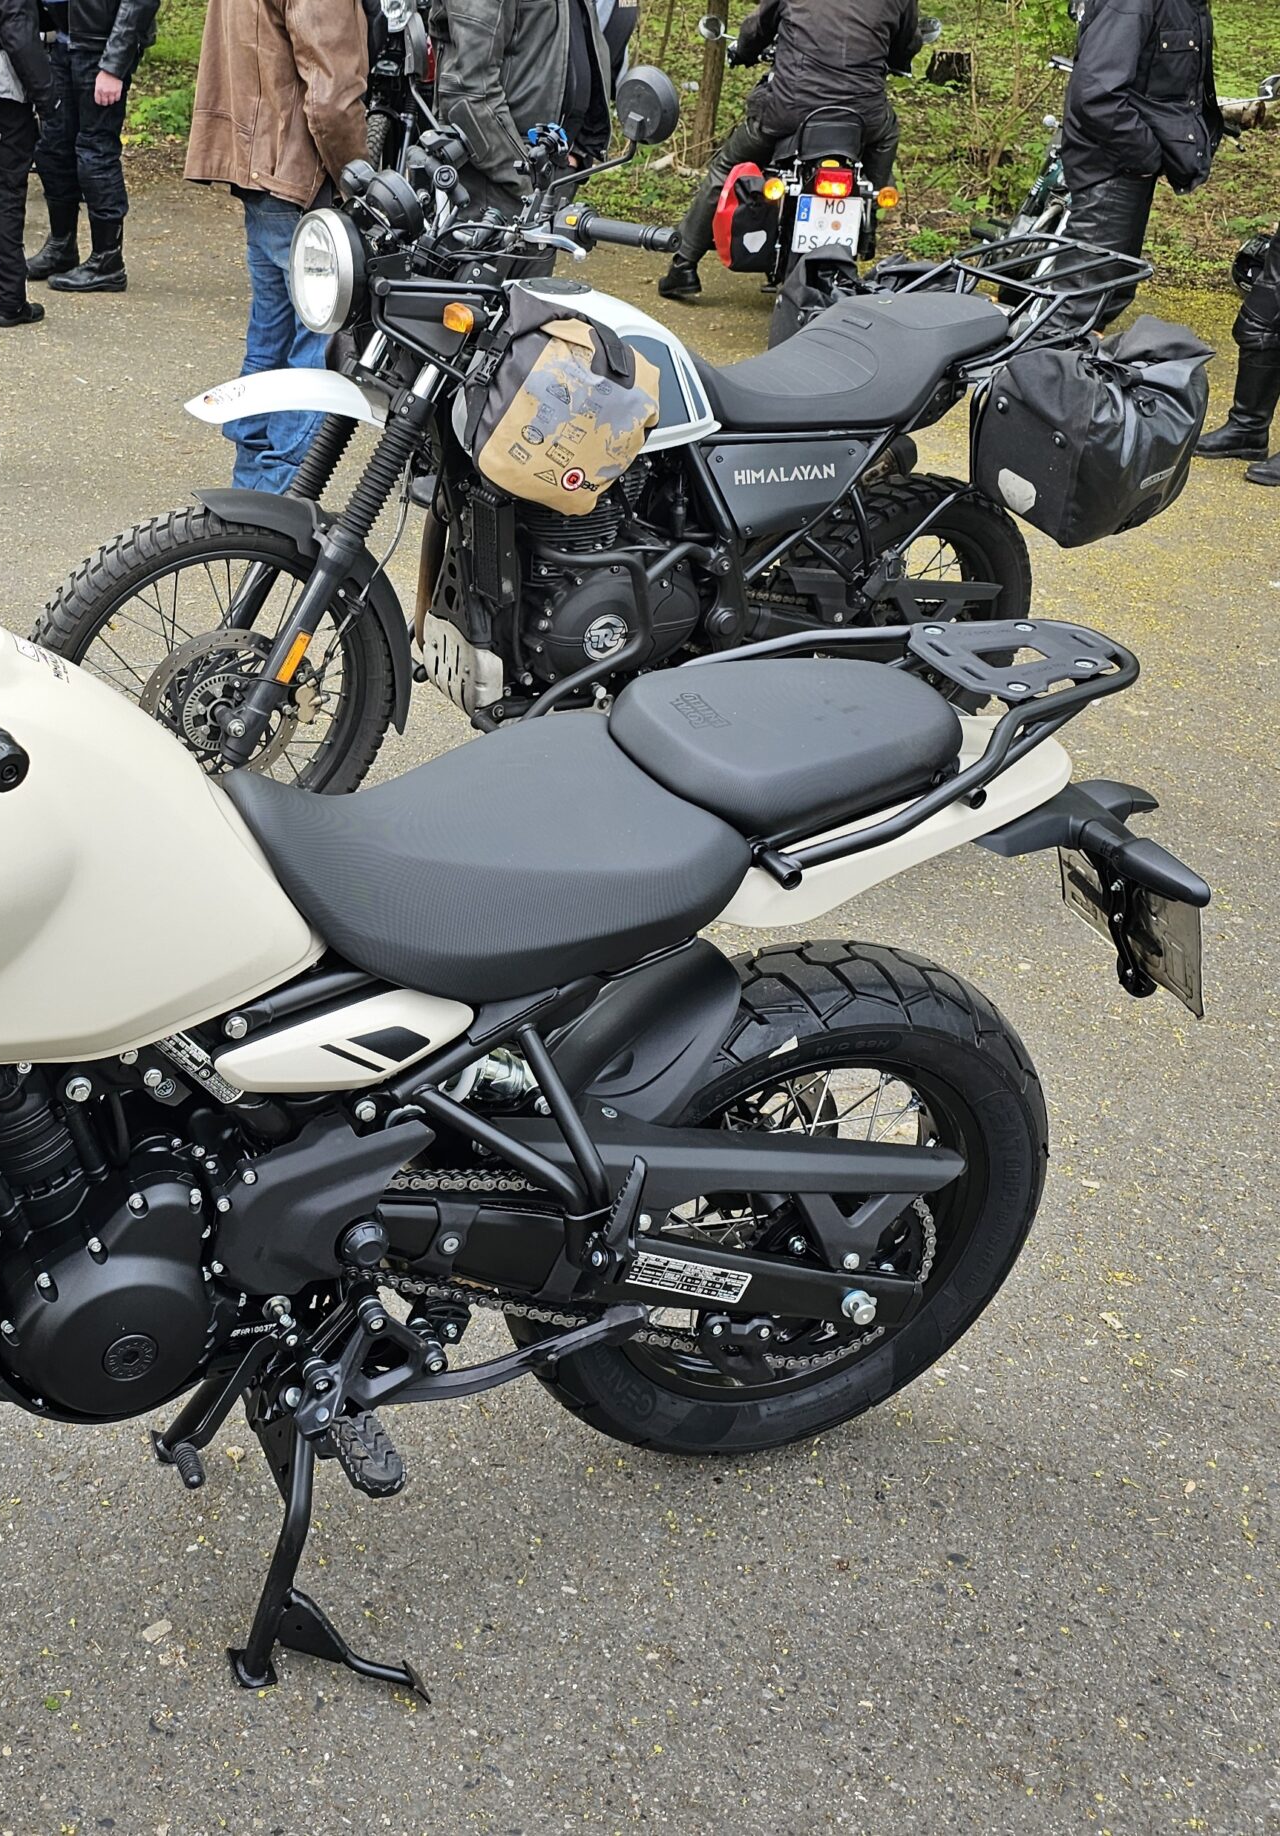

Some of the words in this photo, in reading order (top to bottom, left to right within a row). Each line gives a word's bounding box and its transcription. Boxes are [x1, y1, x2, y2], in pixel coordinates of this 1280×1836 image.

[824, 199, 846, 215] MO
[797, 235, 819, 250] PS
[733, 463, 836, 485] HIMALAYAN
